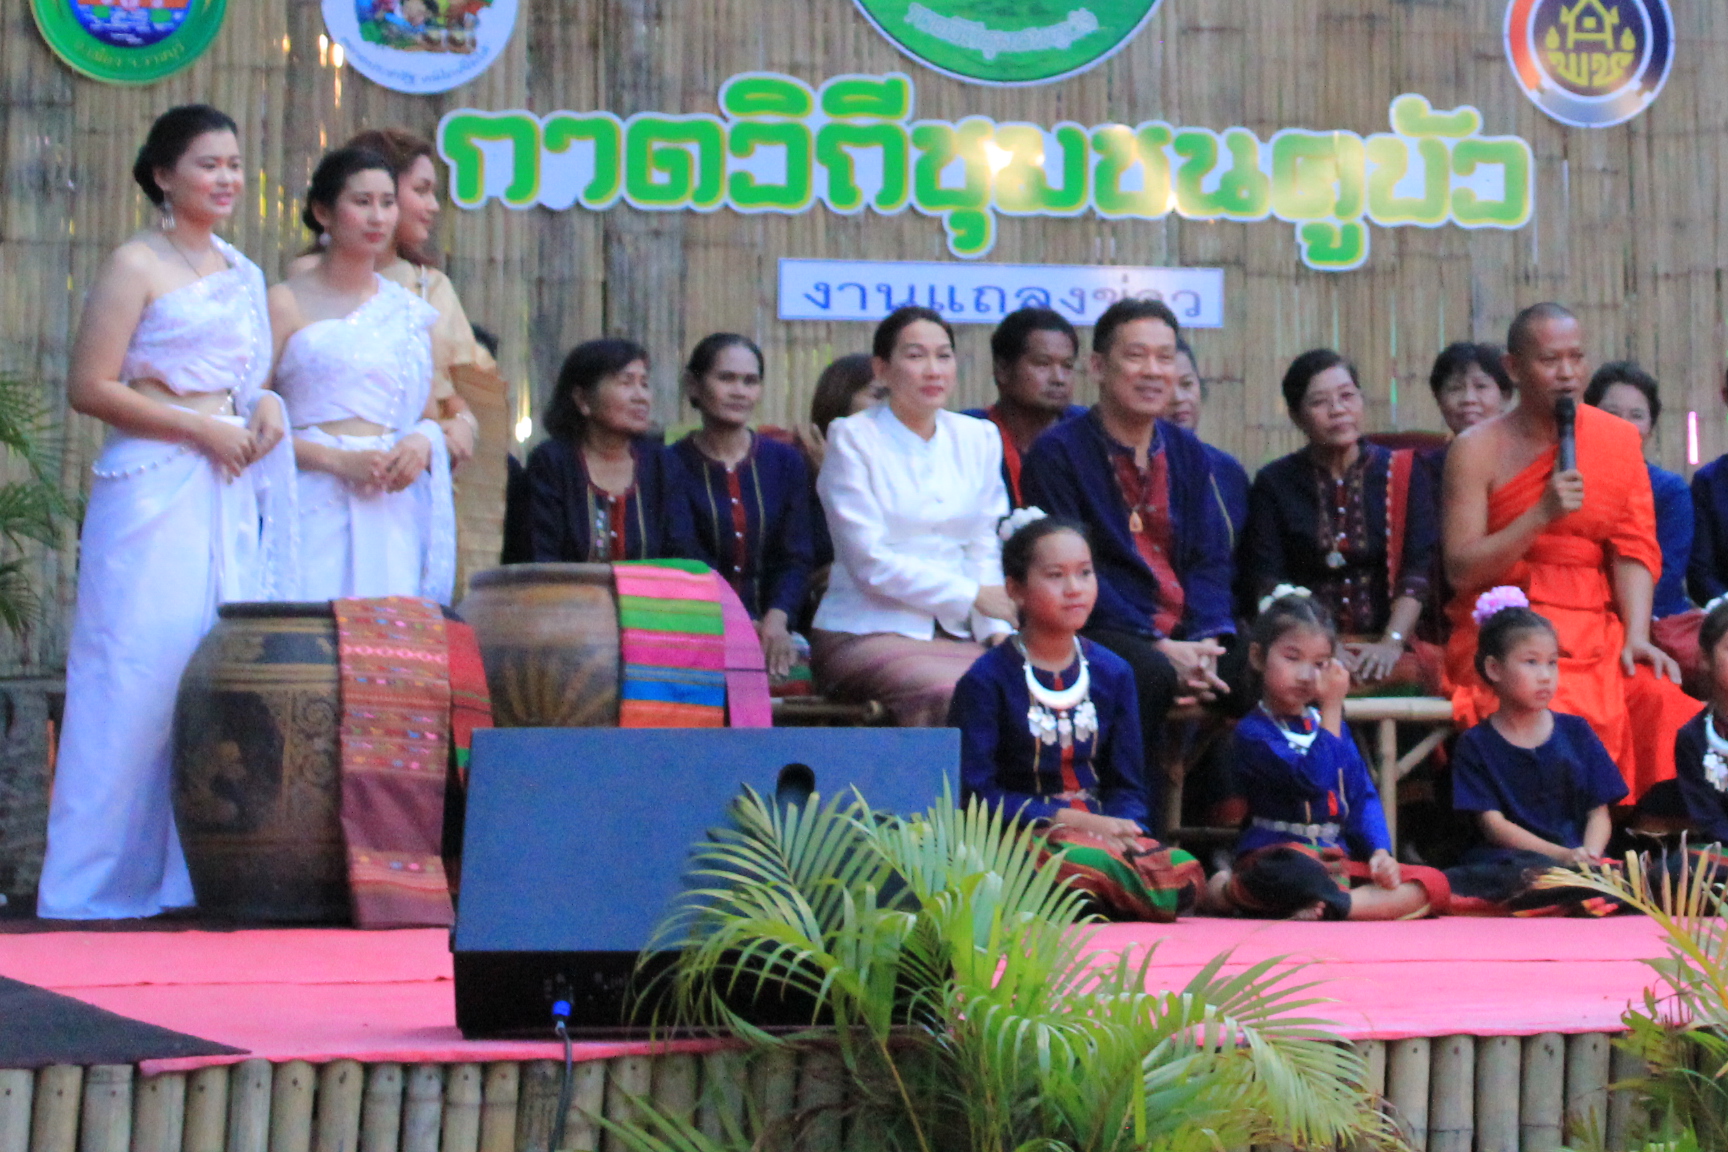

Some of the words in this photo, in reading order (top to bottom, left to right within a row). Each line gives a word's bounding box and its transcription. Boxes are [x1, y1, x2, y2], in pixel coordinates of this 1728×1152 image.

[440, 74, 1533, 265] กาดวิถีชุมชนคูบัว
